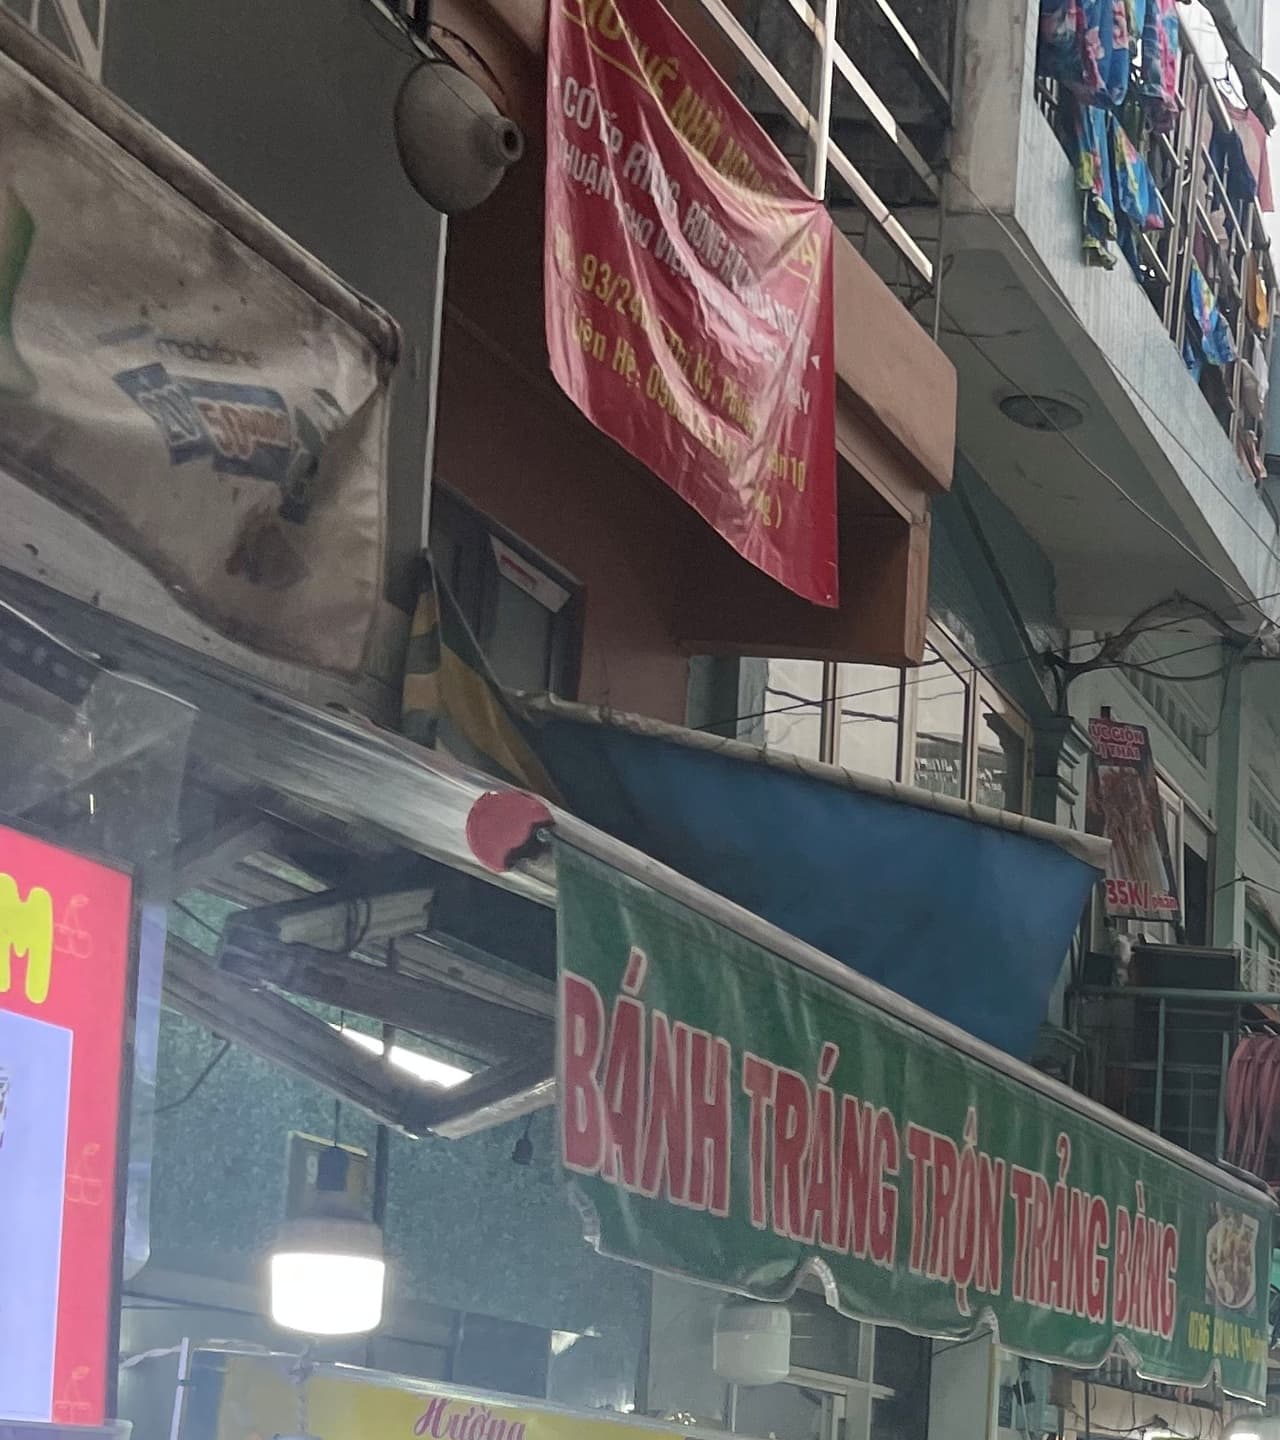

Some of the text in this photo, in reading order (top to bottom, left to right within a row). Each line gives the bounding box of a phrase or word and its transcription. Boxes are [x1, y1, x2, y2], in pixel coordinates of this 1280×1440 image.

[562, 947, 1179, 1341] BÁNH TRÁNG TRỘN TRẢNG BÀNG
